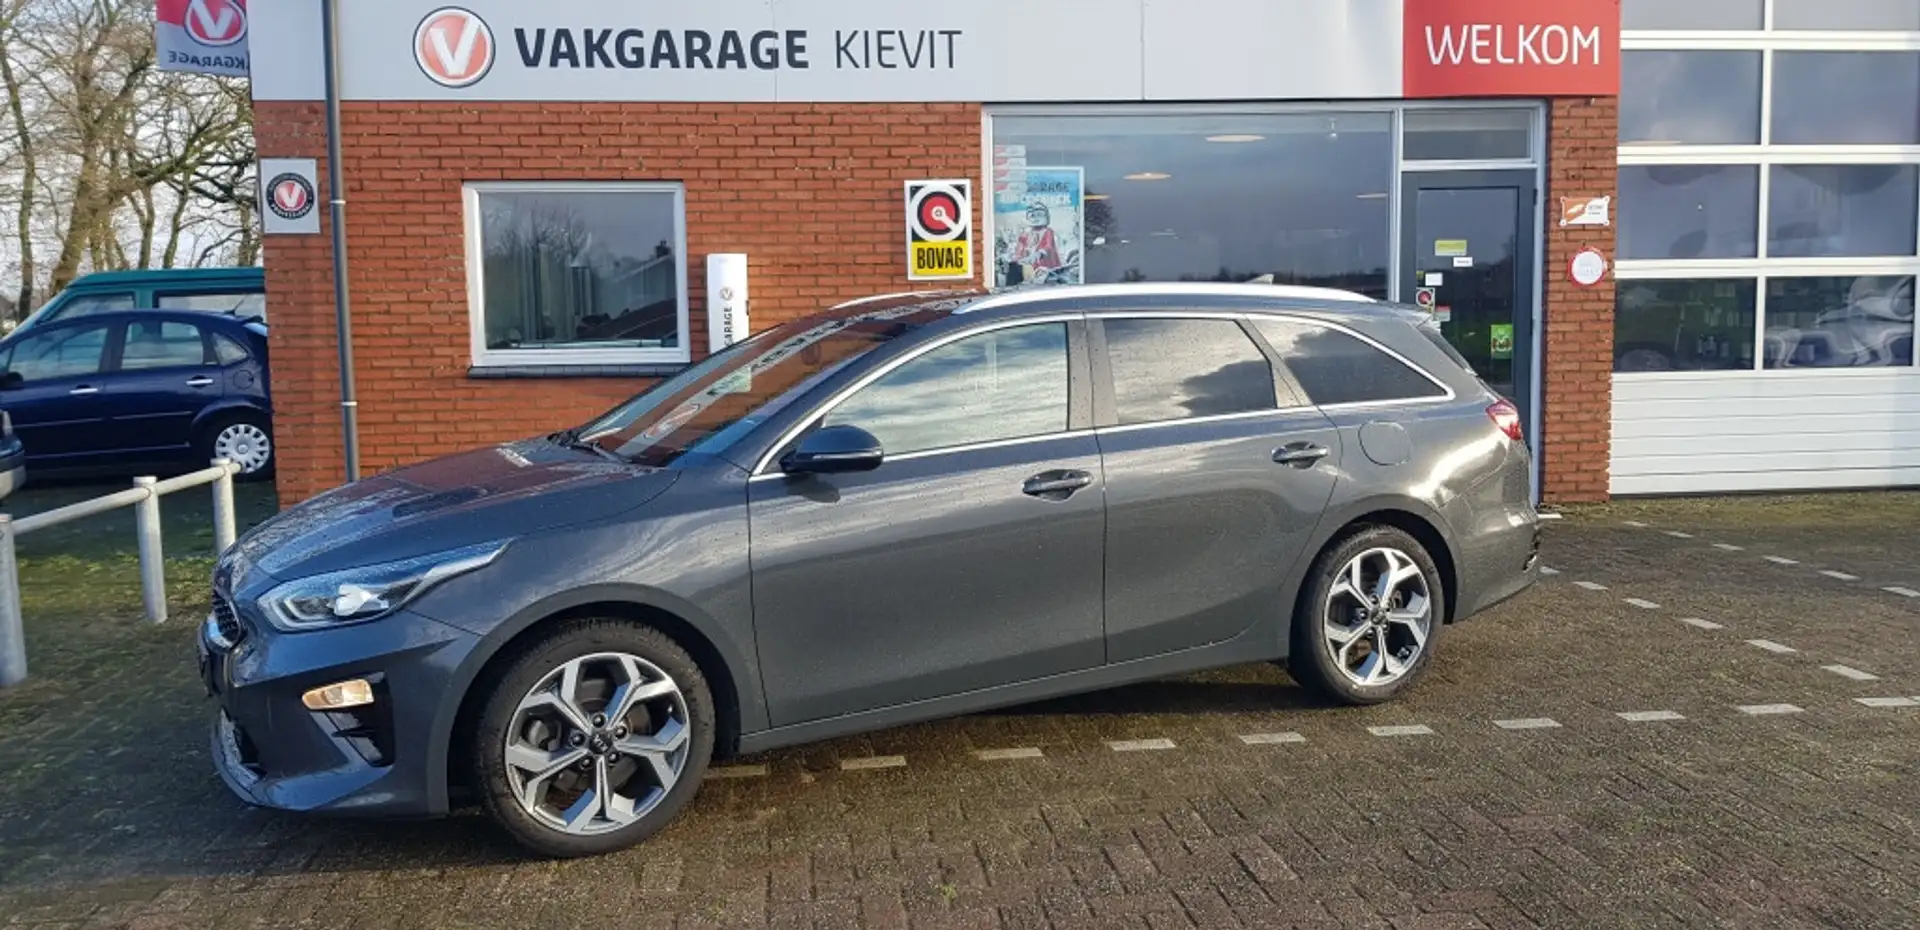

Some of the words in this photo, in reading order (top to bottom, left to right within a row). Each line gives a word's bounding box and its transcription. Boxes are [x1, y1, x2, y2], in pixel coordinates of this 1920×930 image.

[514, 28, 809, 70] VAKGARAGE
[835, 30, 962, 69] KIEVIT
[1425, 24, 1600, 65] WELKOM
[916, 247, 964, 269] BOVAG
